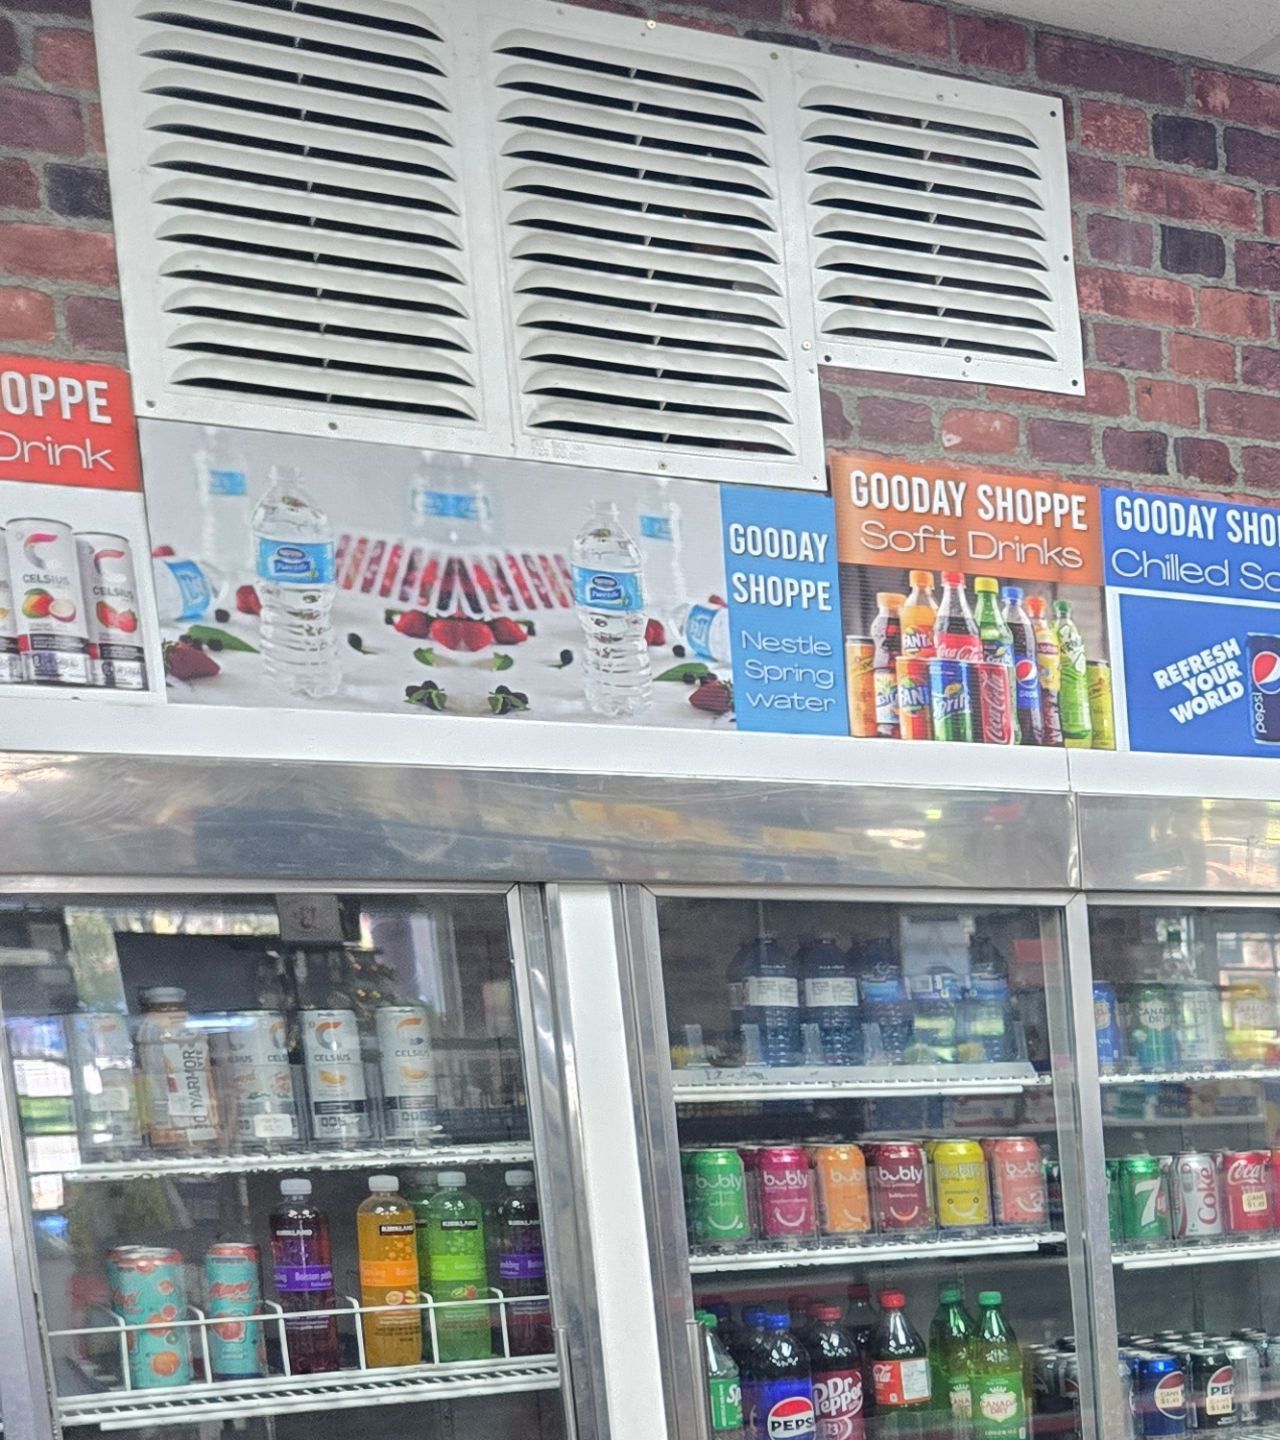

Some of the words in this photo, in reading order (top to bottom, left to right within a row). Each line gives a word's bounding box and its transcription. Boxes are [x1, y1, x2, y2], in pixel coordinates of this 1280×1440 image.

[851, 470, 967, 518] GOODAY
[977, 484, 1088, 531] SHOPPE
[1115, 496, 1217, 540] GOODAY
[729, 523, 828, 563] GOODAY
[860, 520, 957, 557] Soft
[968, 530, 1083, 569] Drinks
[23, 574, 70, 587] CELSIUS
[1112, 548, 1230, 586] Chilled
[733, 572, 831, 612] SHOPPE
[741, 630, 832, 657] Nestle
[744, 659, 834, 690] Spring
[1153, 638, 1241, 690] REFRESH
[1183, 660, 1243, 696] YOUR
[746, 692, 836, 713] water
[1169, 681, 1245, 724] WORLD
[1253, 692, 1267, 734] pepsi
